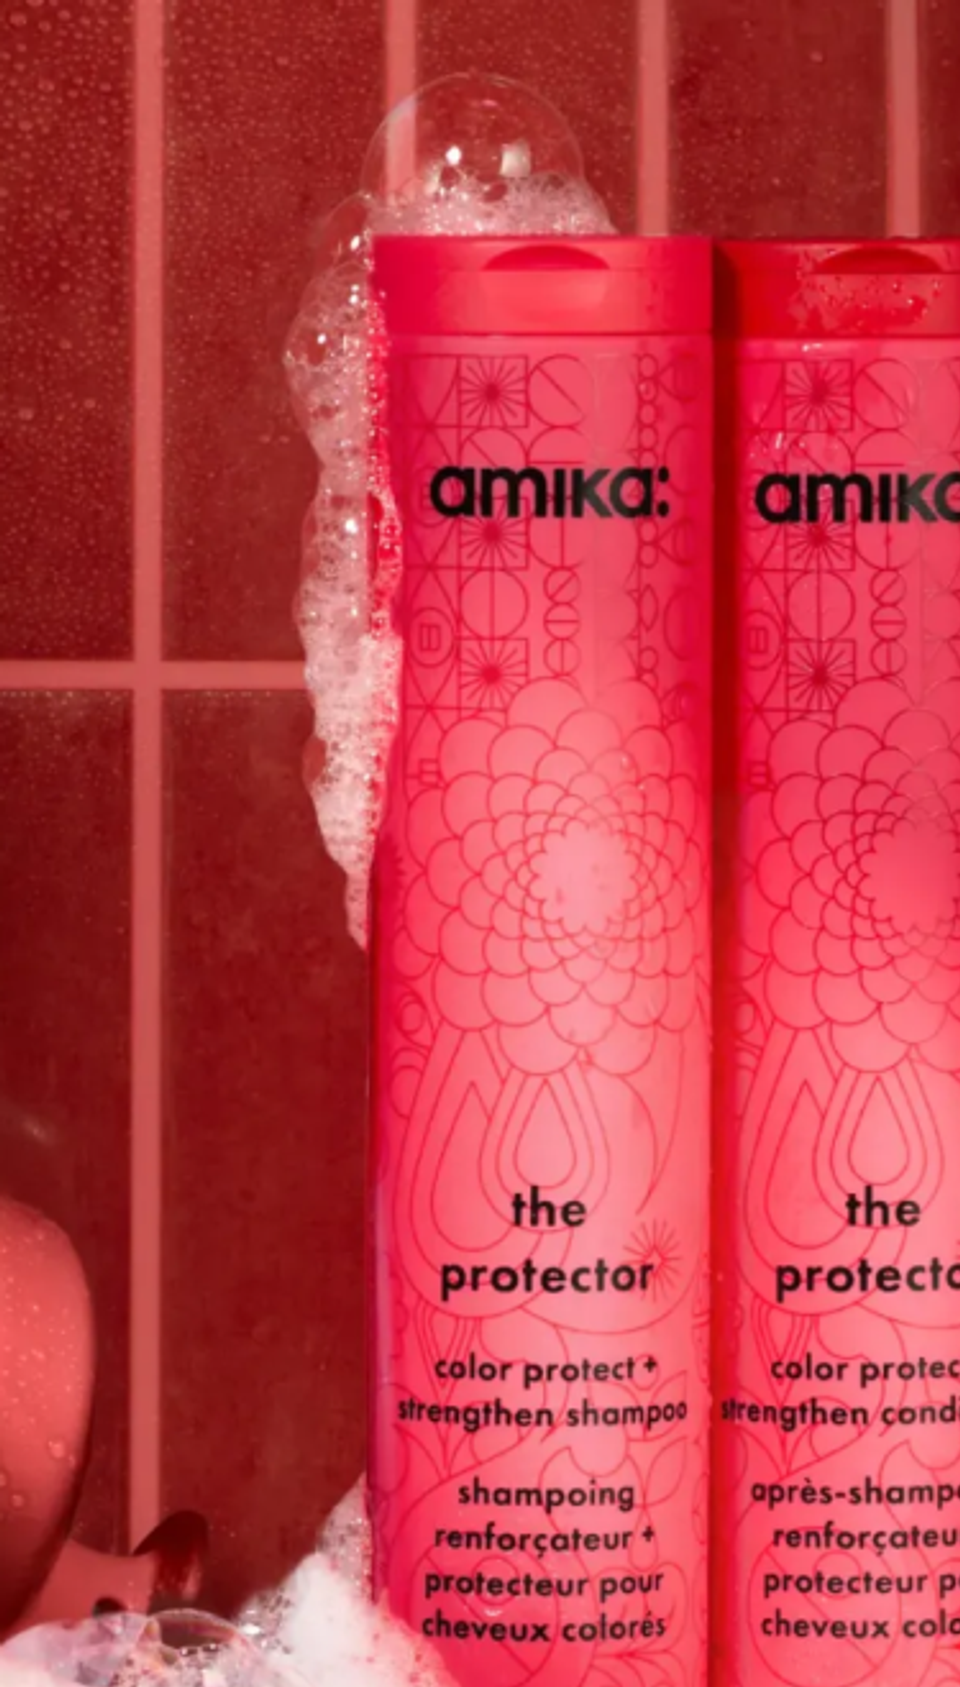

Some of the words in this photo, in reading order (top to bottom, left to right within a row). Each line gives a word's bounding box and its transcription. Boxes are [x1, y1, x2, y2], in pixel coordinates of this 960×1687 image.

[429, 465, 670, 519] amika:
[511, 1184, 587, 1228] the
[845, 1184, 921, 1227] the
[440, 1258, 654, 1303] protector
[434, 1351, 513, 1382] color
[523, 1356, 636, 1390] protect
[770, 1351, 849, 1382] color
[397, 1397, 554, 1434] strengthen
[566, 1398, 688, 1431] shampoo
[719, 1396, 869, 1433] strengthen
[458, 1476, 635, 1515] shampoing
[434, 1520, 633, 1559] renforçateur
[424, 1571, 589, 1600] protecteur
[599, 1573, 664, 1604] pour
[763, 1570, 928, 1599] protecteur
[421, 1610, 550, 1643] cheveux
[561, 1610, 666, 1643] colorés
[760, 1608, 890, 1640] cheveux
